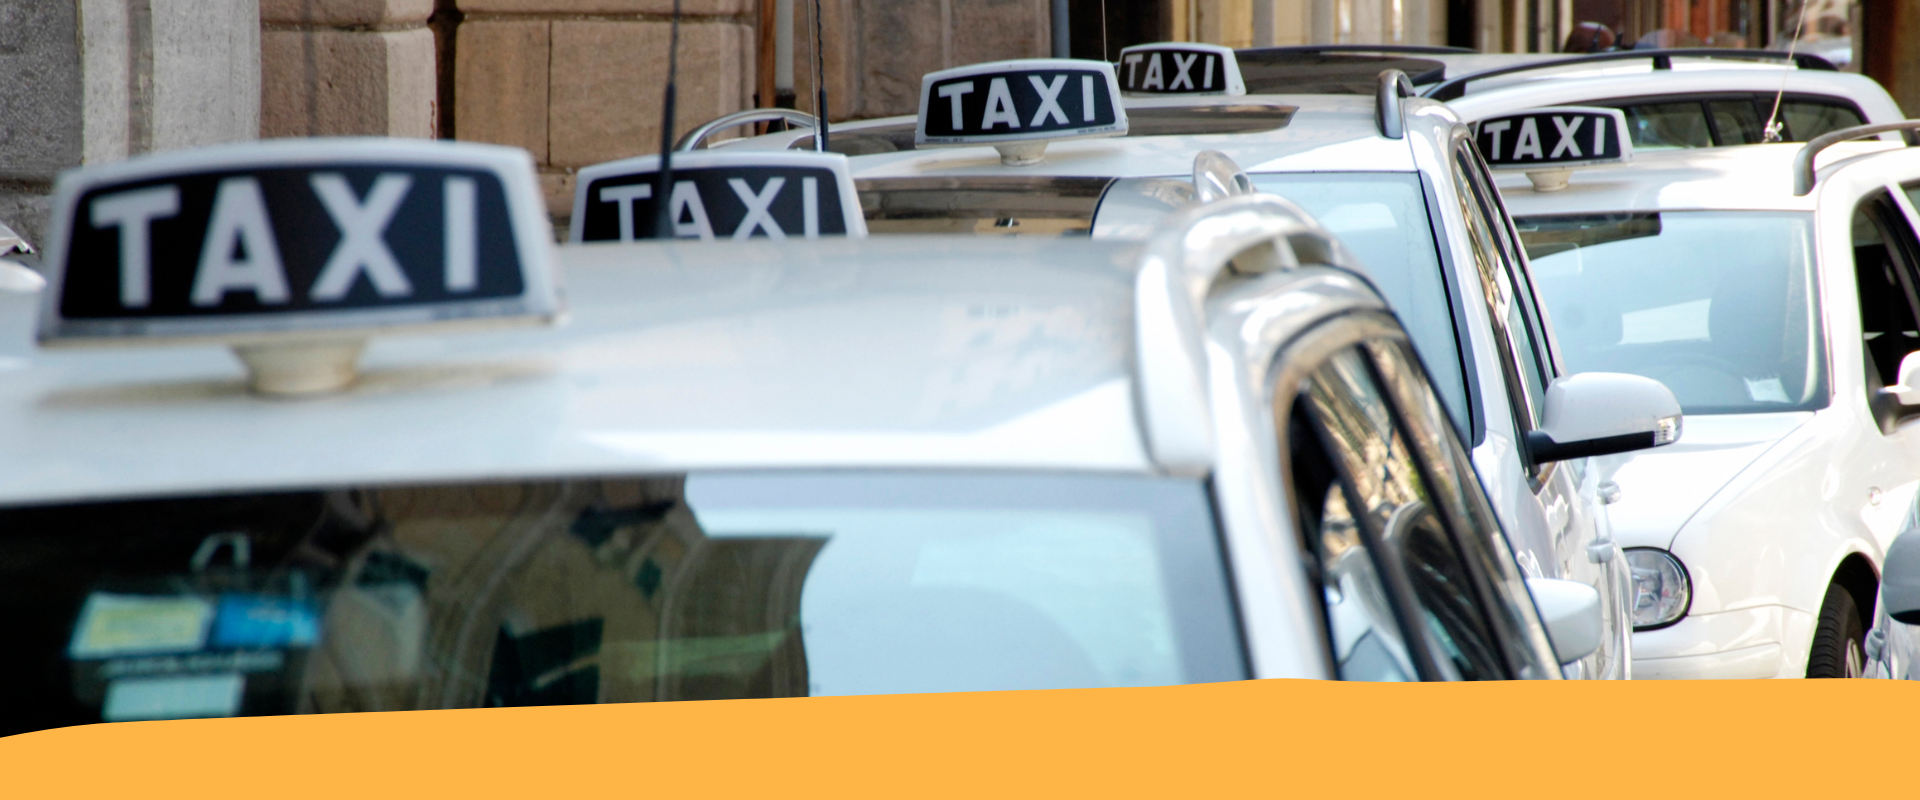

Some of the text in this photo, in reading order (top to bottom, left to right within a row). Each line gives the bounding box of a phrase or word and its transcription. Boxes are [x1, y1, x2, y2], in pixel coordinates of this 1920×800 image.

[1125, 52, 1215, 91] TAXI
[938, 74, 1096, 131] TAXI
[1484, 115, 1606, 161] TAXI
[600, 176, 819, 241] TAXI
[91, 173, 479, 307] TAXI
